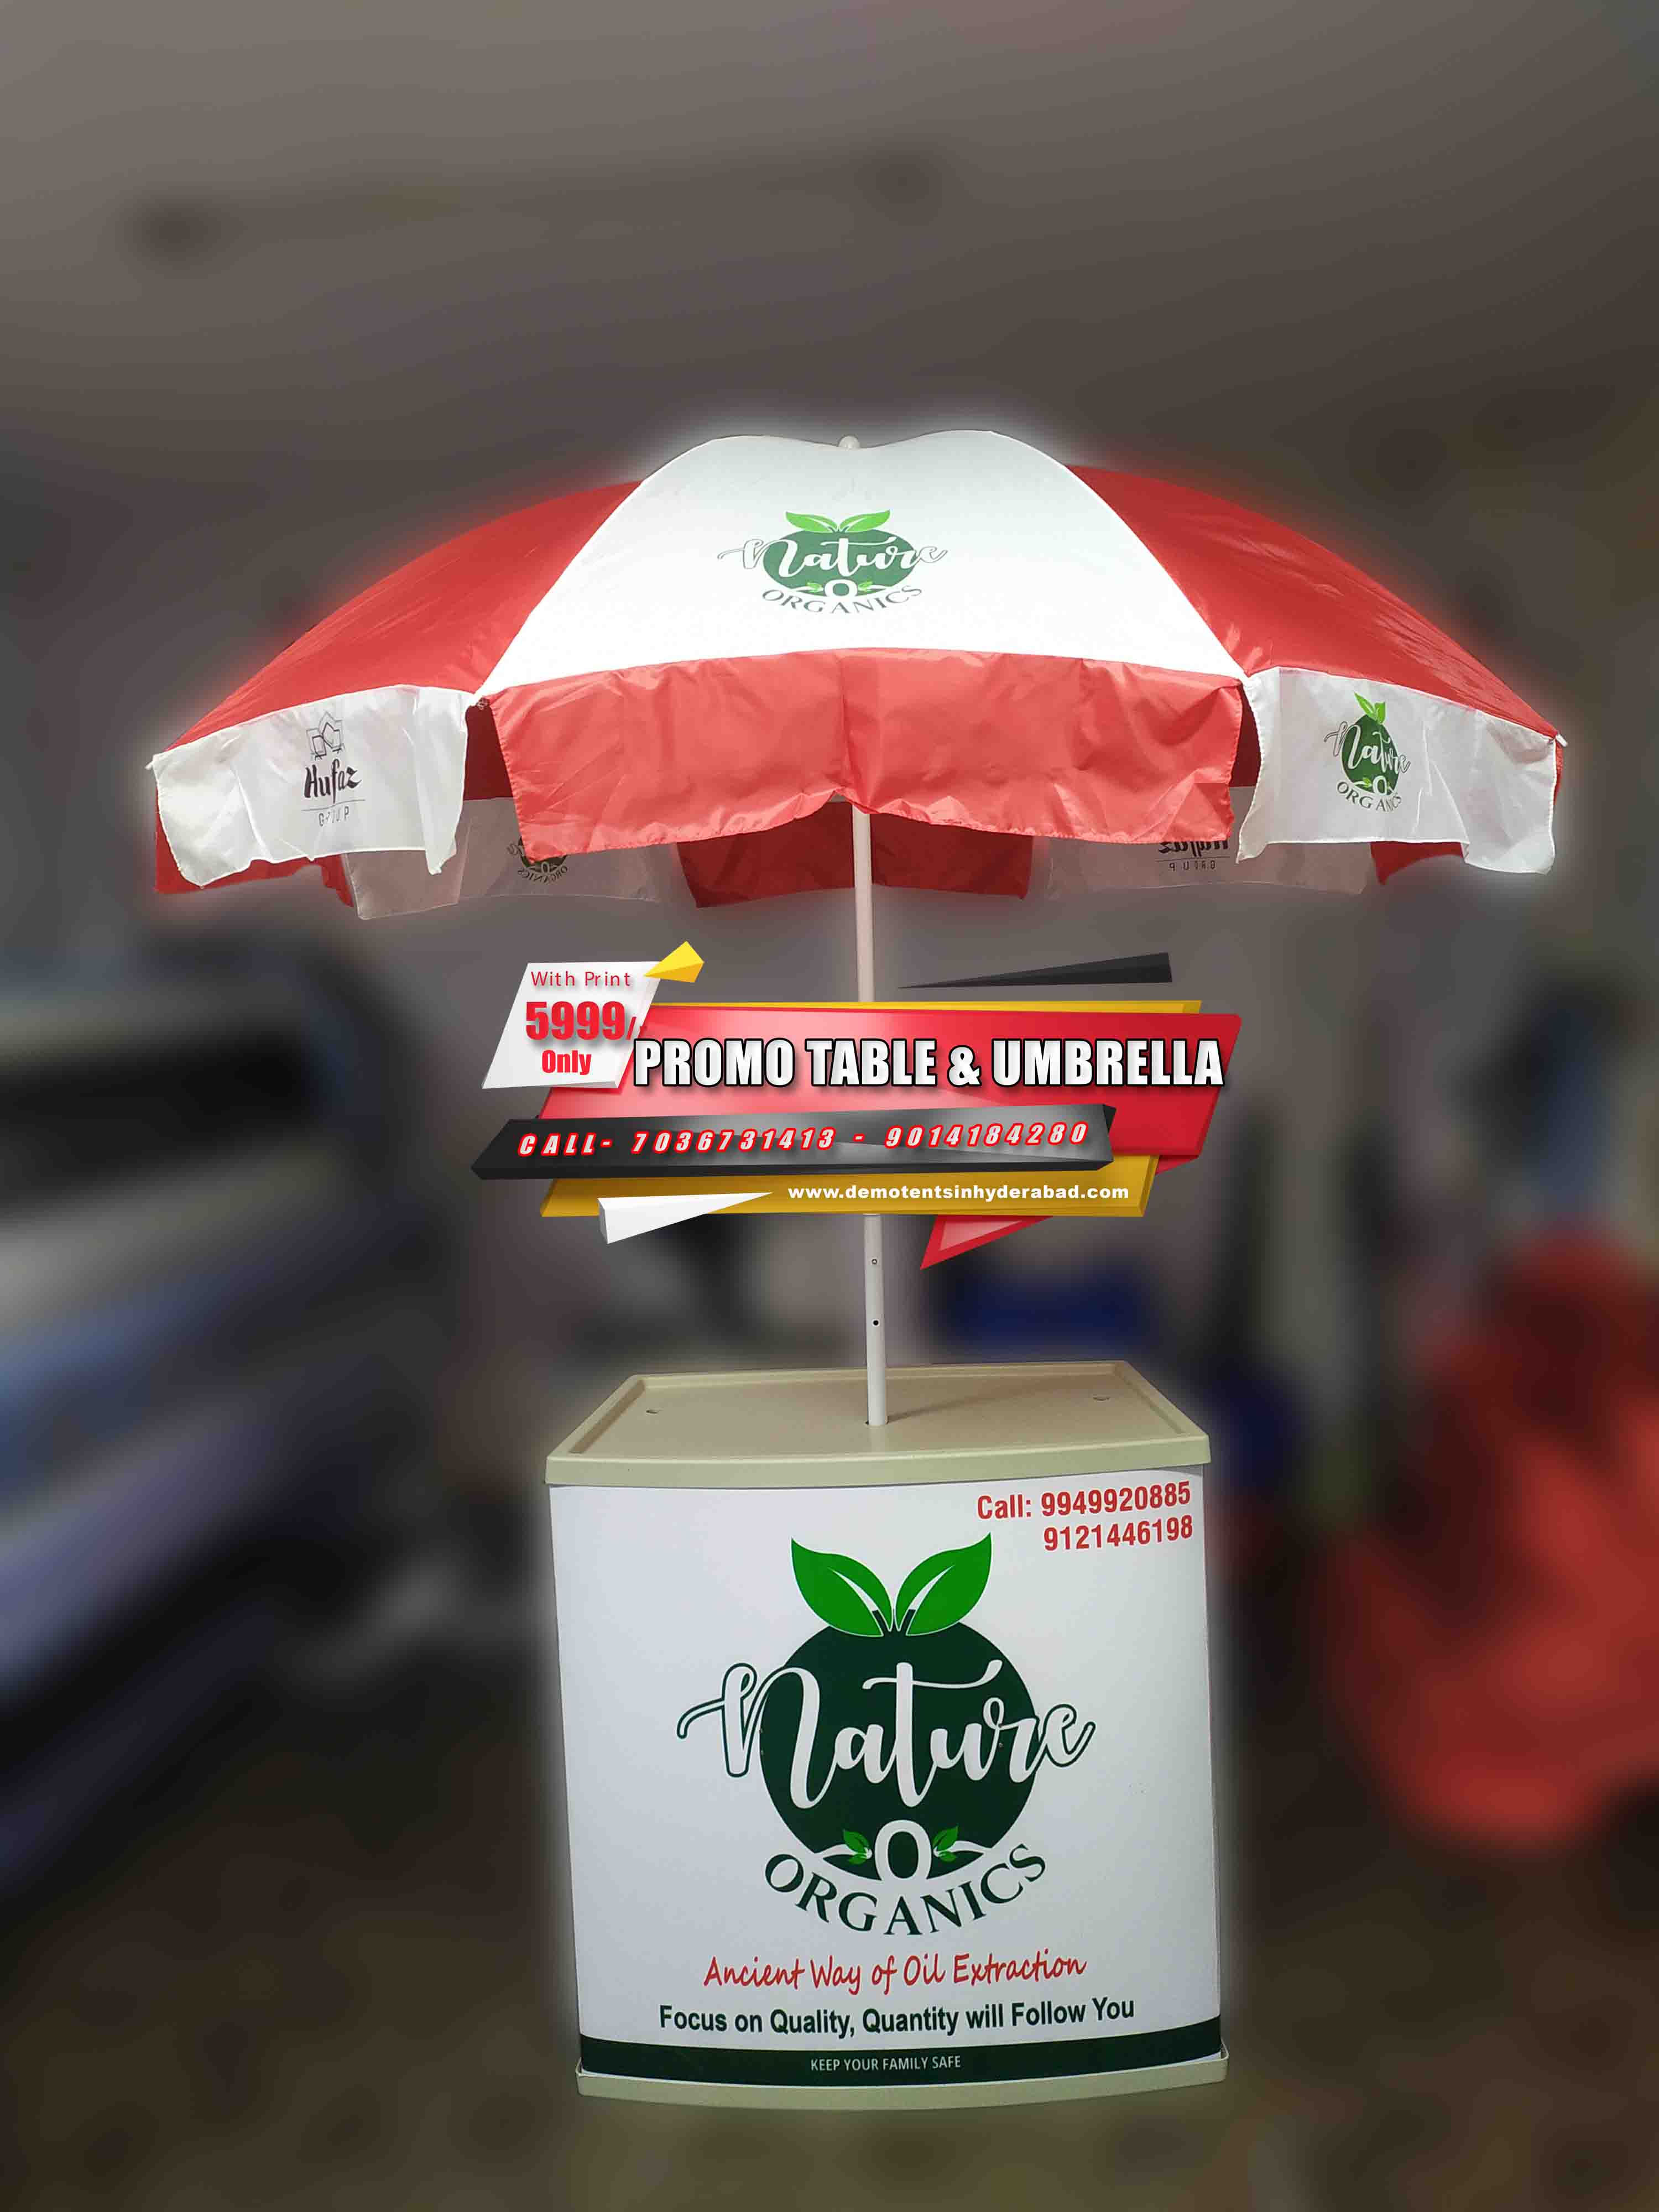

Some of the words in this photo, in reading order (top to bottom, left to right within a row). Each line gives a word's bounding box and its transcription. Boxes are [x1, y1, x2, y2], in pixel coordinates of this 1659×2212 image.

[761, 585, 922, 614] ORGANICS
[304, 758, 362, 804] Hufaz
[977, 1494, 1031, 1520] Call:
[1041, 1480, 1191, 1517] 9949920885
[1044, 1515, 1193, 1551] 9121446198
[765, 1843, 1046, 1936] ORGANICS
[703, 1955, 806, 1990] Ancient
[810, 1955, 862, 1995] Way
[872, 1955, 898, 1995] of
[903, 1953, 946, 1986] Oil
[953, 1948, 1088, 1987] Extraction
[659, 2004, 727, 2032] Focus
[734, 2013, 763, 2033] on
[770, 2008, 855, 2039] Quality,
[862, 2006, 959, 2037] Quantity
[966, 2003, 1004, 2029] will
[1011, 2000, 1087, 2026] Follow
[1092, 1996, 1135, 2021] You
[810, 2058, 841, 2072] KEEP
[843, 2058, 879, 2071] YOUR
[883, 2056, 928, 2070] FAMILY
[931, 2055, 961, 2069] SAFE
